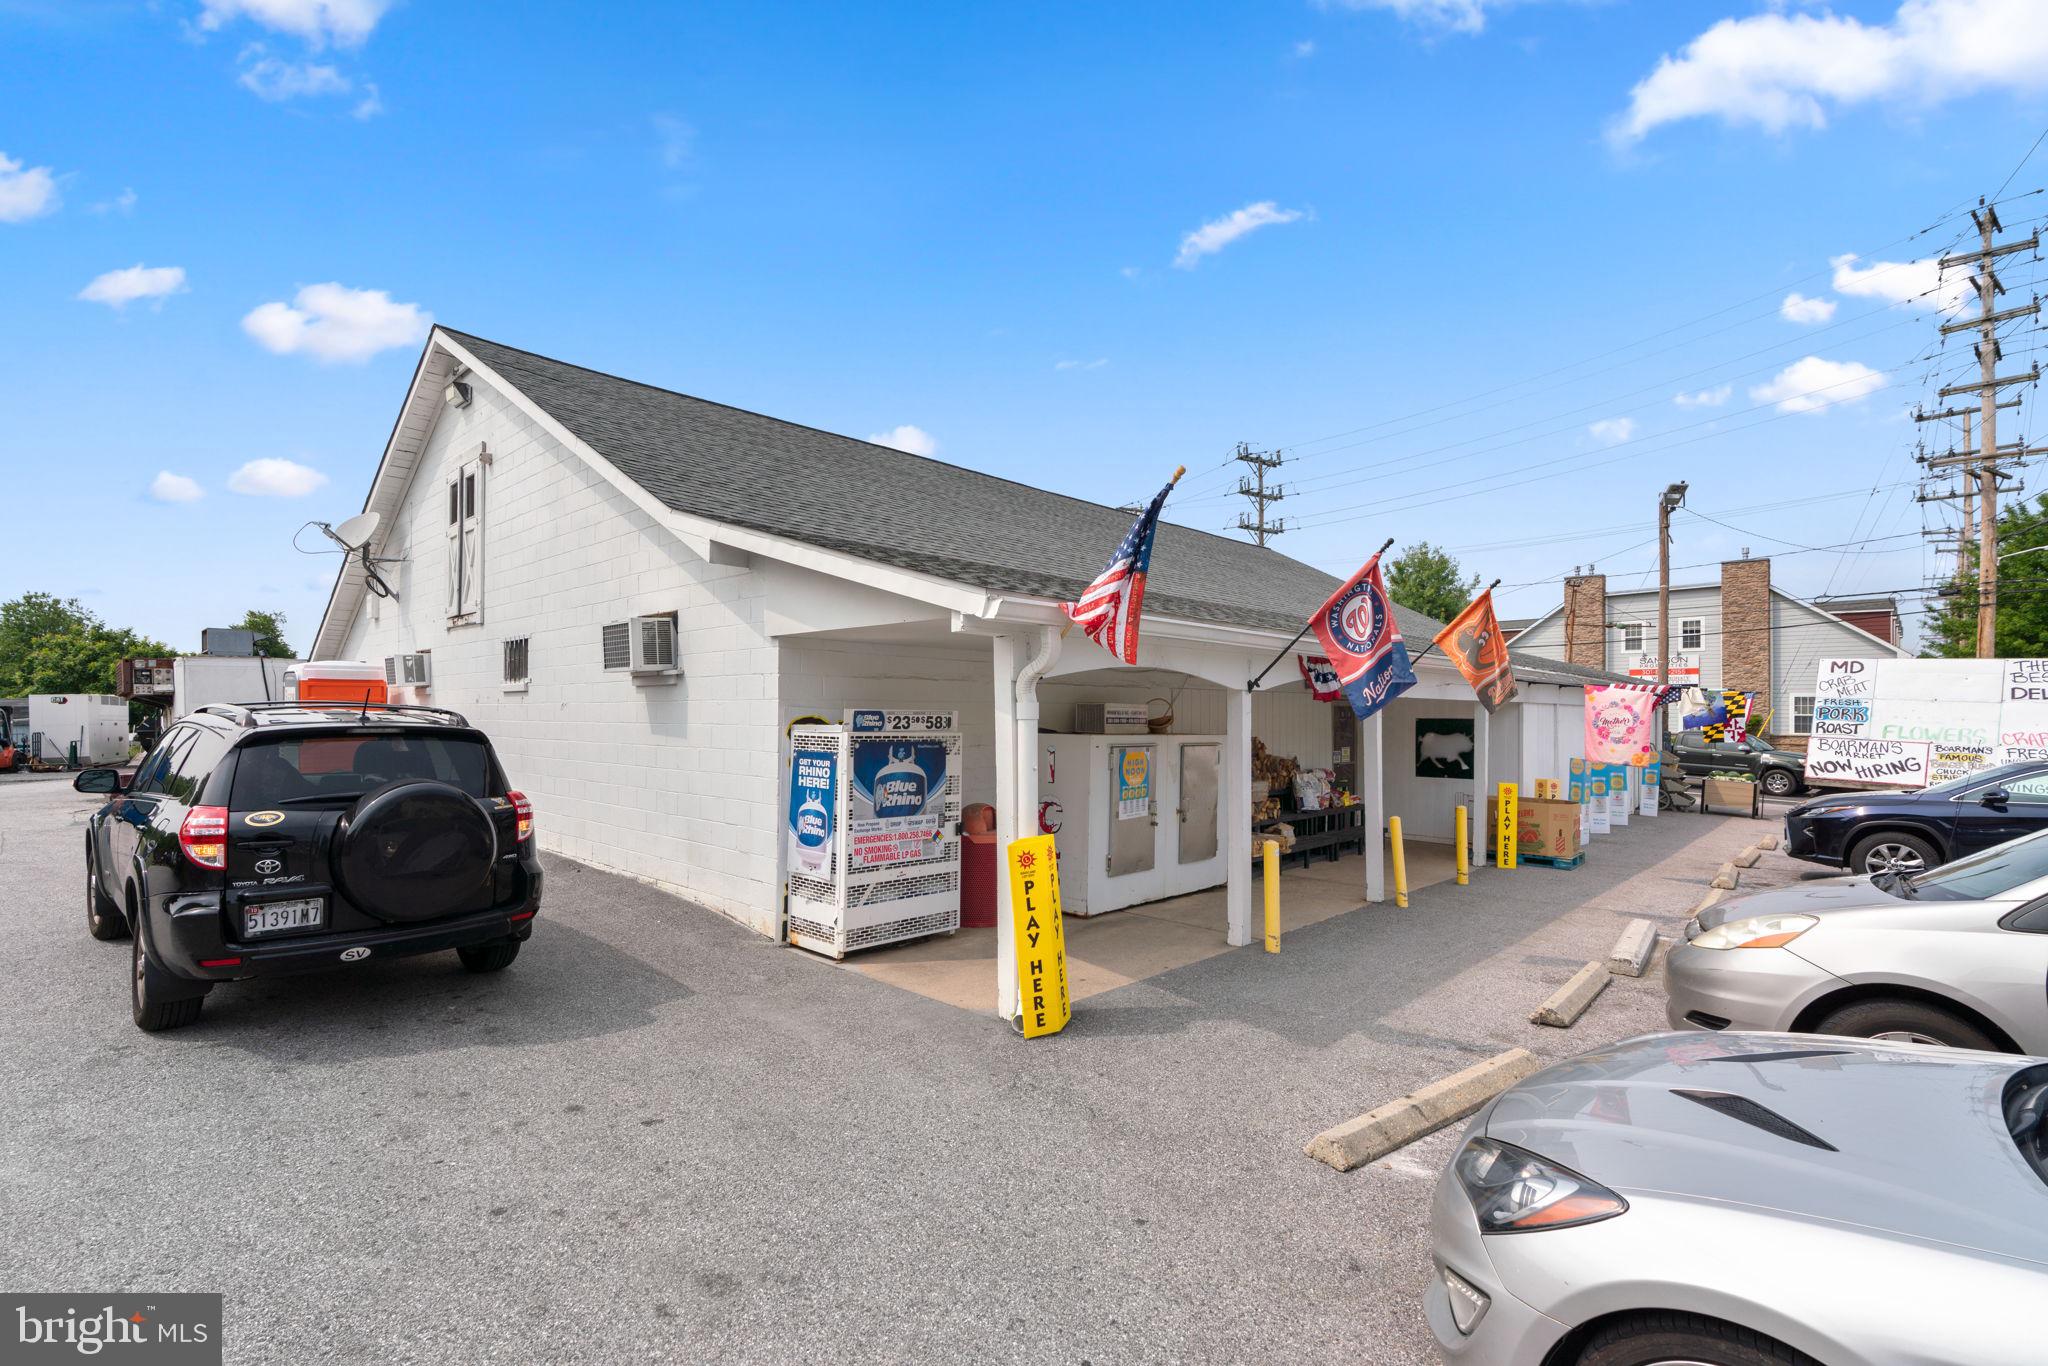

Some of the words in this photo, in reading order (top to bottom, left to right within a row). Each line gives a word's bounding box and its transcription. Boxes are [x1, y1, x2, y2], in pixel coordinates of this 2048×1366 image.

[1830, 660, 1865, 673] MD
[1819, 675, 1856, 691] CRAB
[1837, 680, 1870, 698] MEAT
[1818, 707, 1864, 720] PORK
[1816, 721, 1864, 734] ROAST
[1882, 724, 1987, 744] FLOWERS
[1817, 738, 1903, 755] BOARMAN'S
[1834, 750, 1886, 759] MARKET
[1939, 754, 1984, 763] FAMOUS
[798, 758, 811, 766] GET
[812, 759, 831, 768] YOUR
[1126, 759, 1144, 767] HIGH
[1809, 758, 1853, 777] NOW
[1854, 757, 1922, 779] HIRING
[798, 766, 831, 778] RHINO
[1126, 767, 1145, 776] NOON
[798, 775, 830, 789] HERE!
[886, 780, 917, 793] Blue
[804, 815, 823, 826] Blue
[854, 847, 863, 857] NO
[863, 844, 892, 856] SMOKING
[863, 852, 900, 864] FLAMMABLE
[901, 850, 910, 860] LP
[910, 849, 922, 858] GAS
[1503, 835, 1511, 865] HERE
[263, 874, 305, 885] RAV4
[248, 907, 319, 930] 51391M7
[1024, 880, 1040, 948] PLAY
[1050, 873, 1060, 940] PLAY
[1057, 950, 1067, 1018] HERE
[345, 949, 367, 960] SV
[1030, 958, 1047, 1028] HERE
